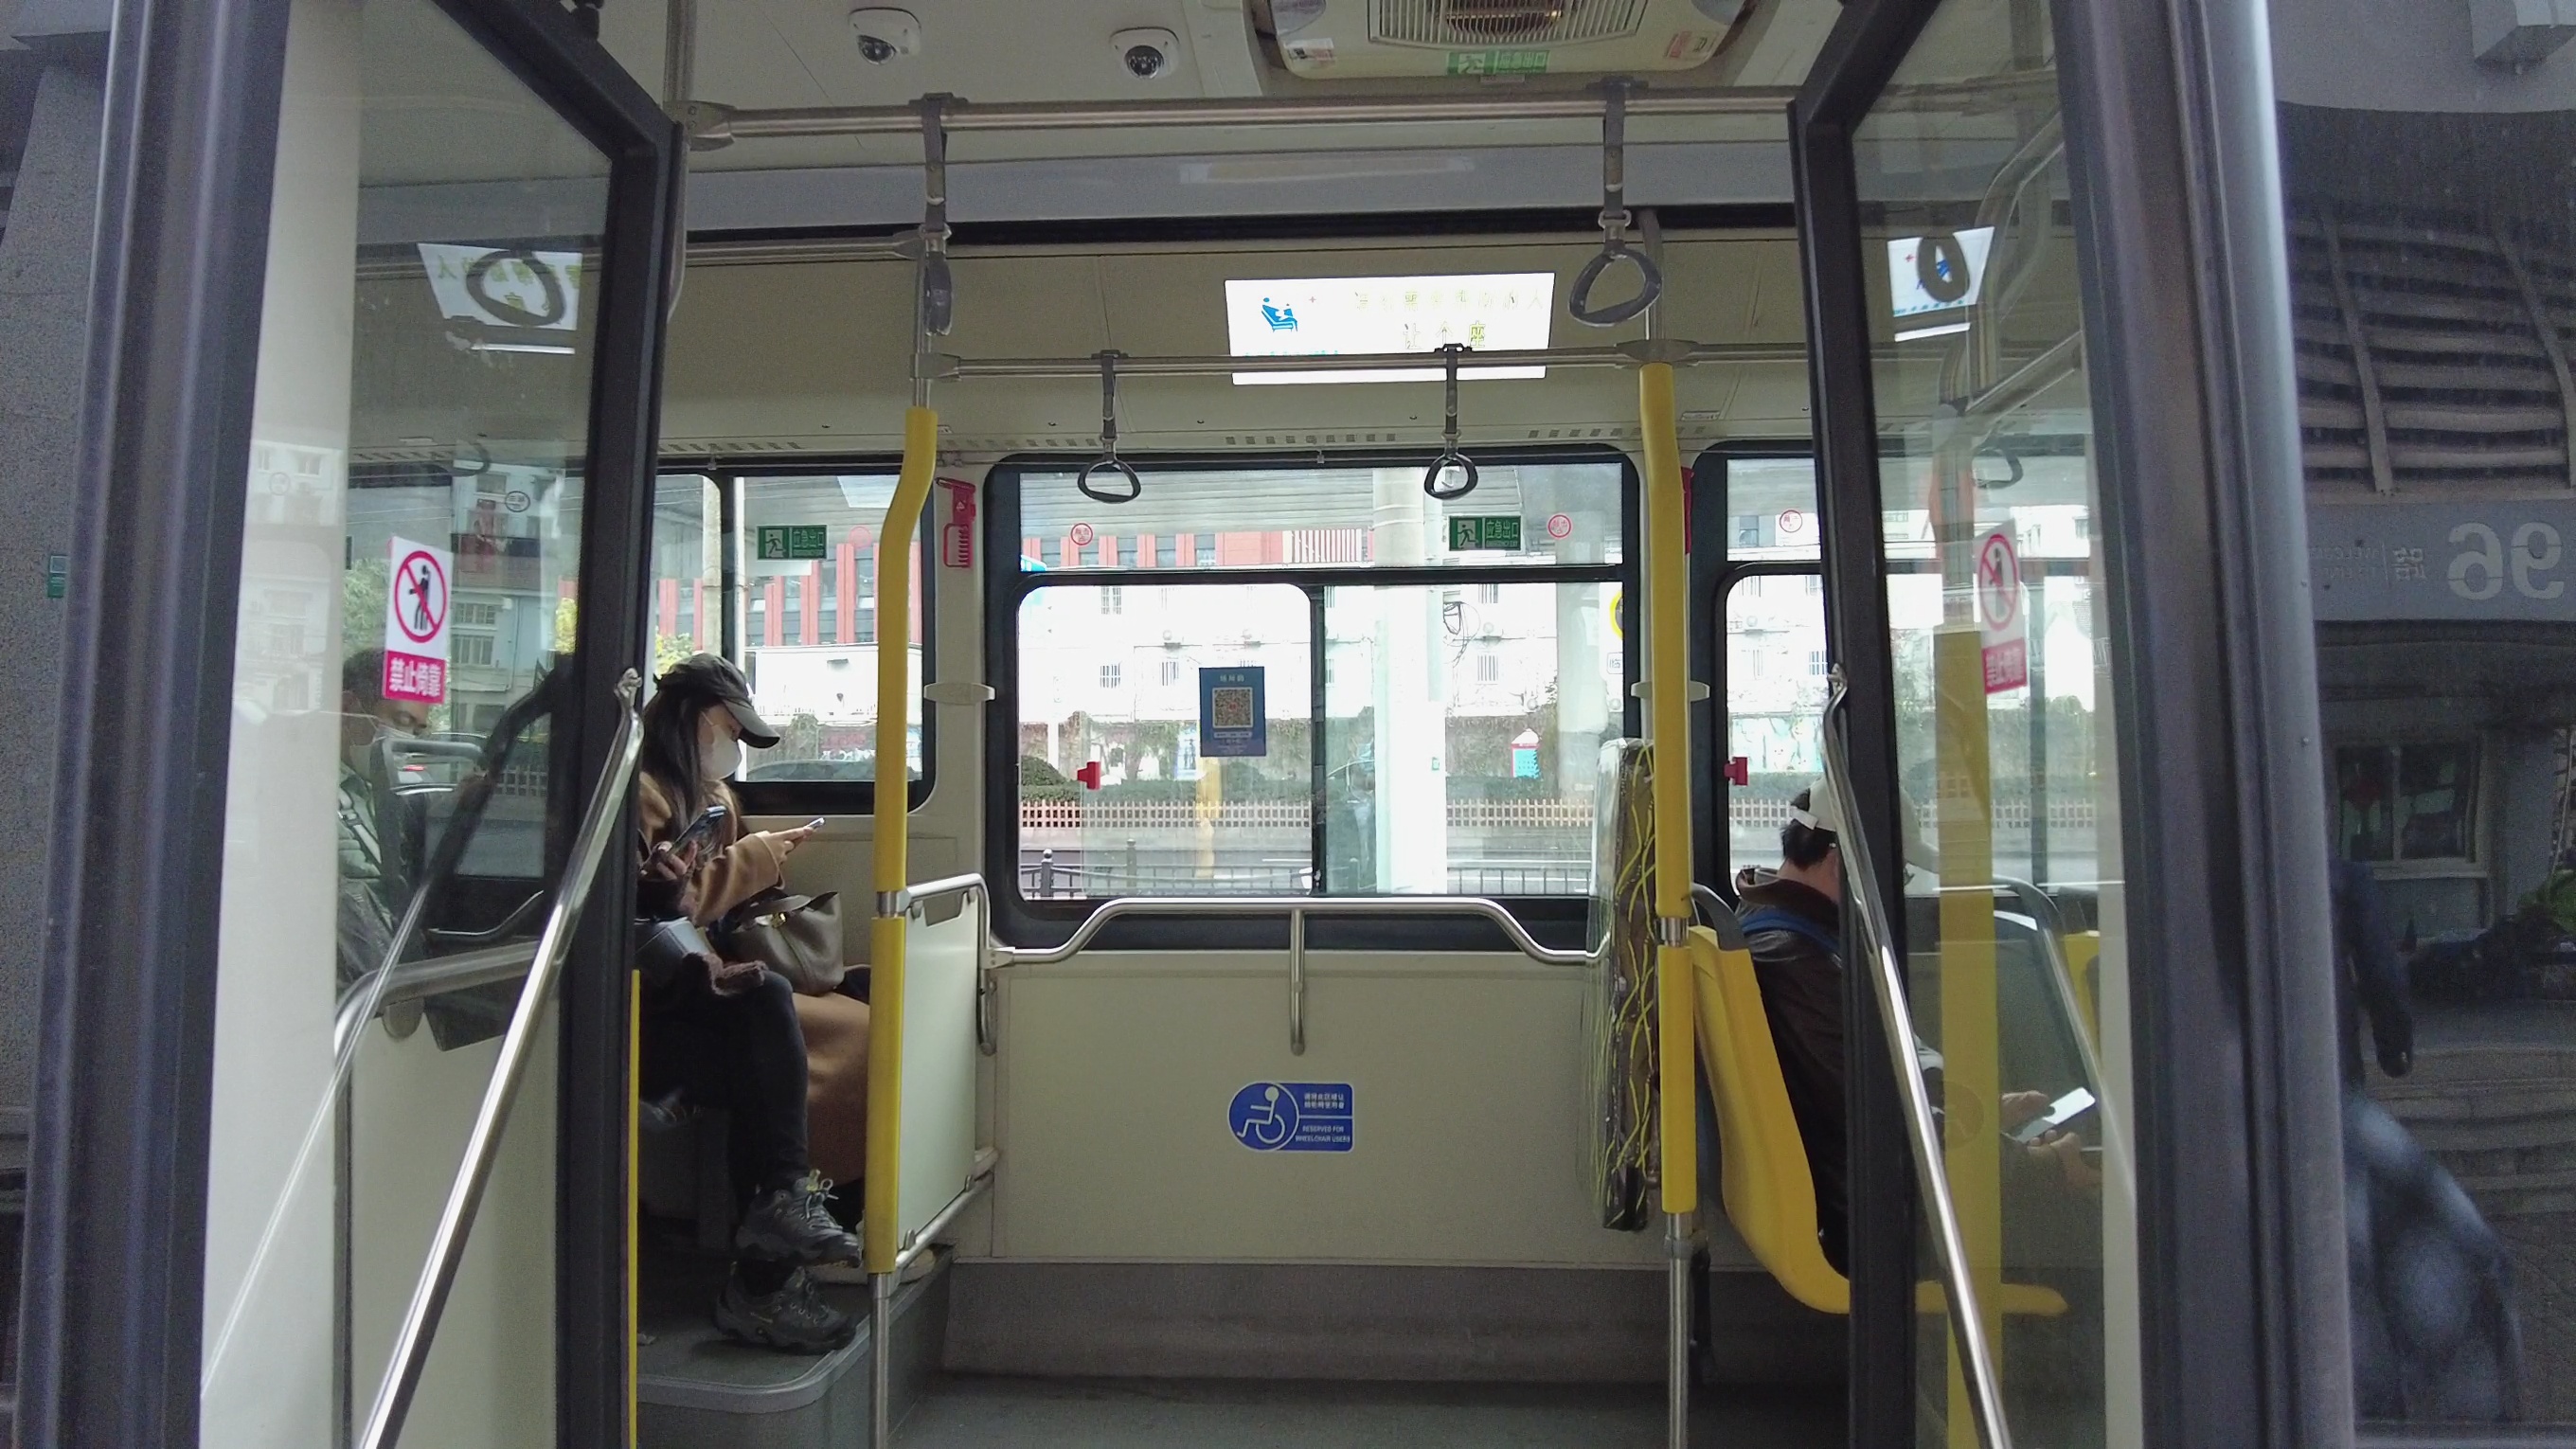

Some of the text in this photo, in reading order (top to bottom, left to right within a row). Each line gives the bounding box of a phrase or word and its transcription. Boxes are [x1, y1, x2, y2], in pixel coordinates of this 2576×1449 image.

[1487, 520, 1519, 539] 应急出口
[389, 657, 442, 698] 禁止倚靠
